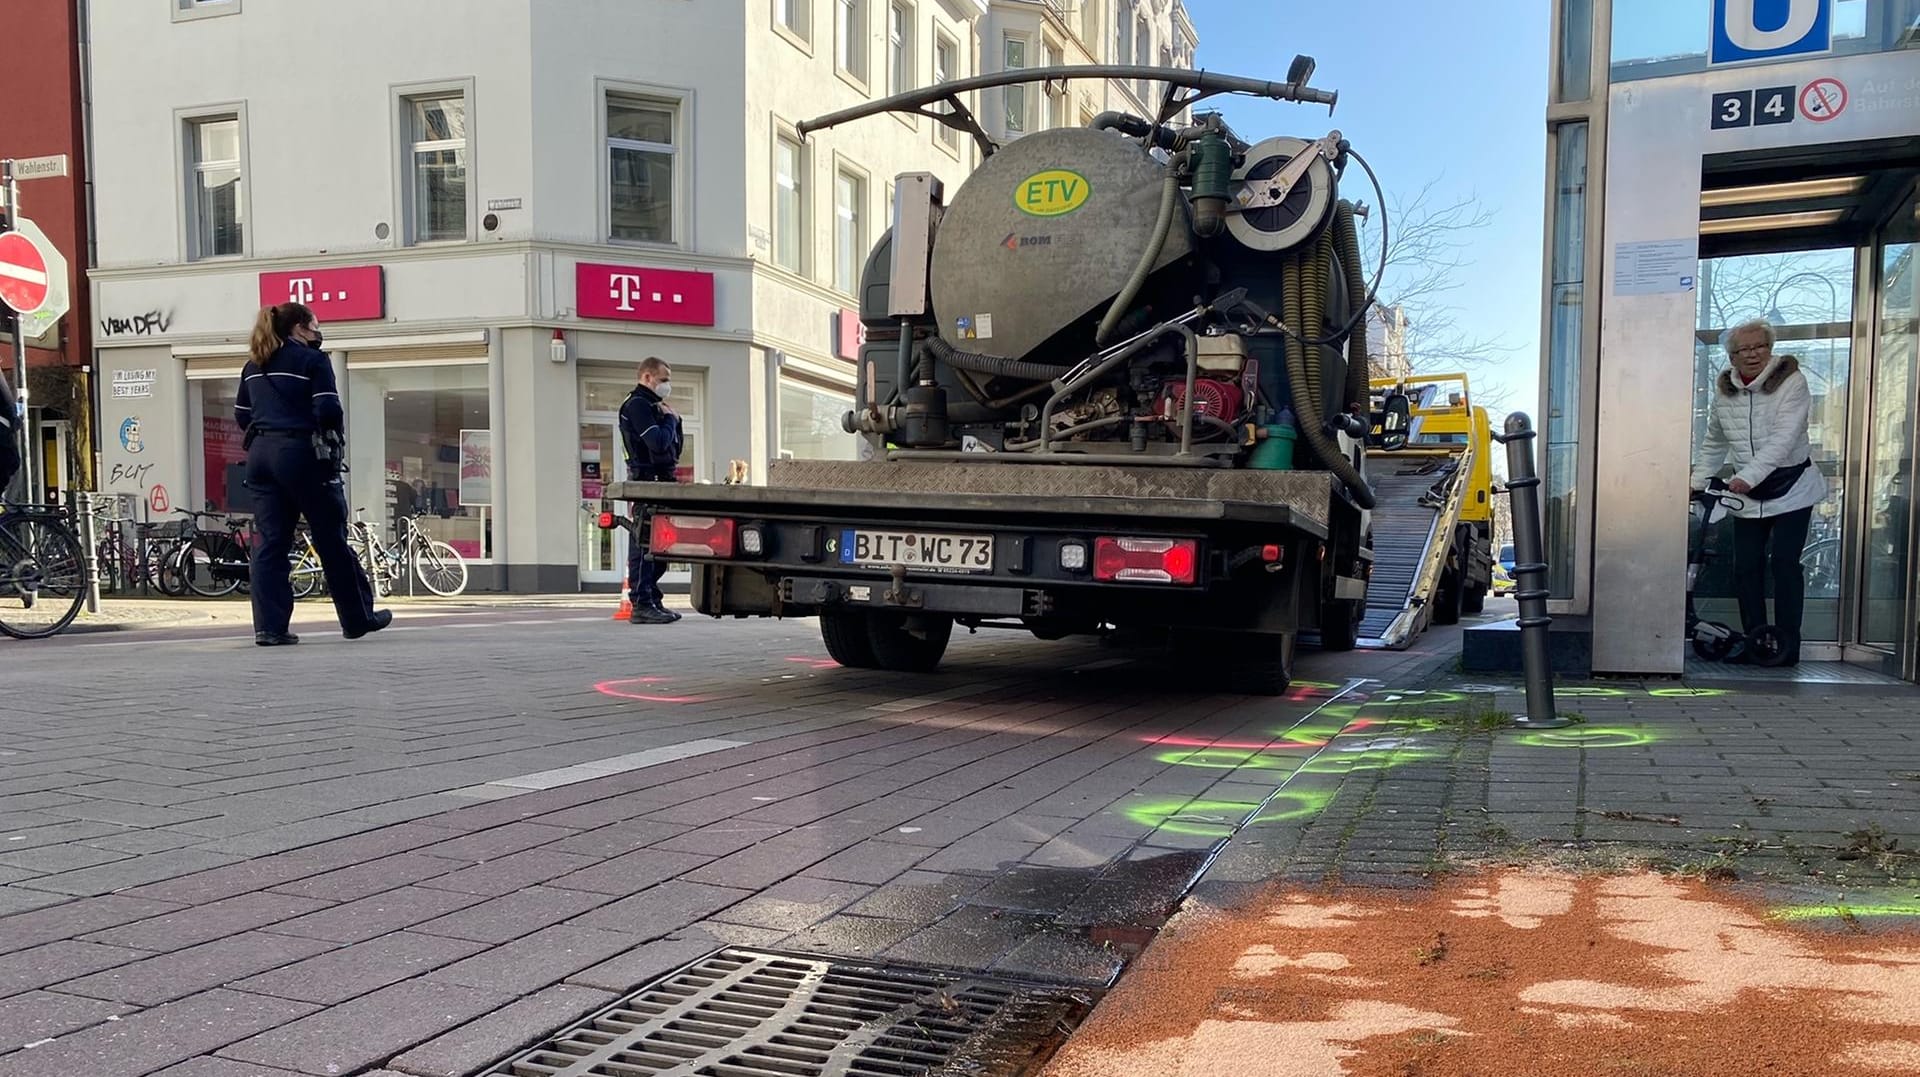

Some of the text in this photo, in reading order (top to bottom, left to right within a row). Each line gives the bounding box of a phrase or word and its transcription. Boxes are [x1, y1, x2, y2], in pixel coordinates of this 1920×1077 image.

[1721, 94, 1785, 122] 3 4
[1026, 179, 1078, 204] ETV
[856, 534, 903, 561] BIT
[920, 537, 952, 564] WC
[959, 539, 990, 566] 73
